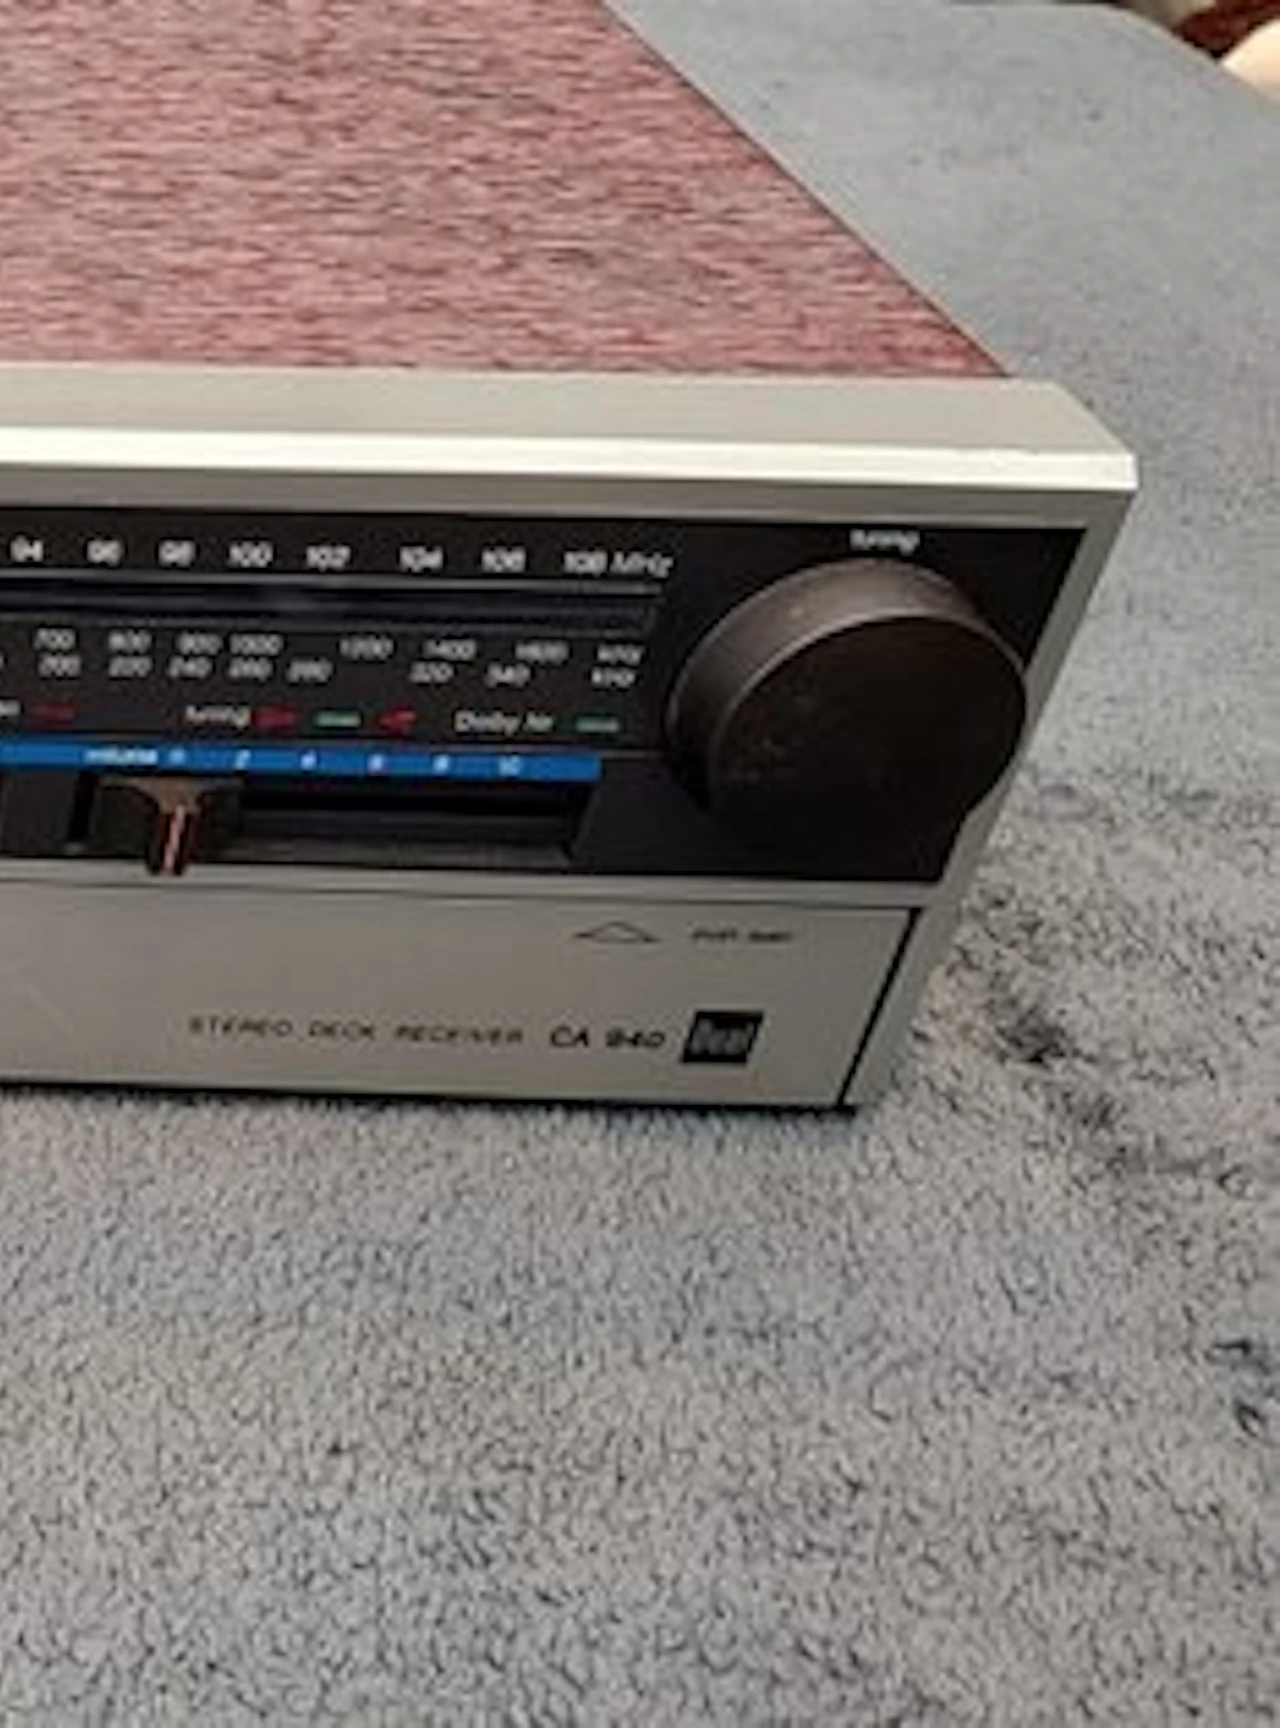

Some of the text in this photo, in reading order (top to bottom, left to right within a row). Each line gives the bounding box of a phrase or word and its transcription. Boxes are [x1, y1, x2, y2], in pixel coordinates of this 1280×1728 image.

[10, 536, 45, 563] 94
[228, 541, 274, 569] 100
[33, 627, 76, 651] 700
[549, 1024, 591, 1049] CA
